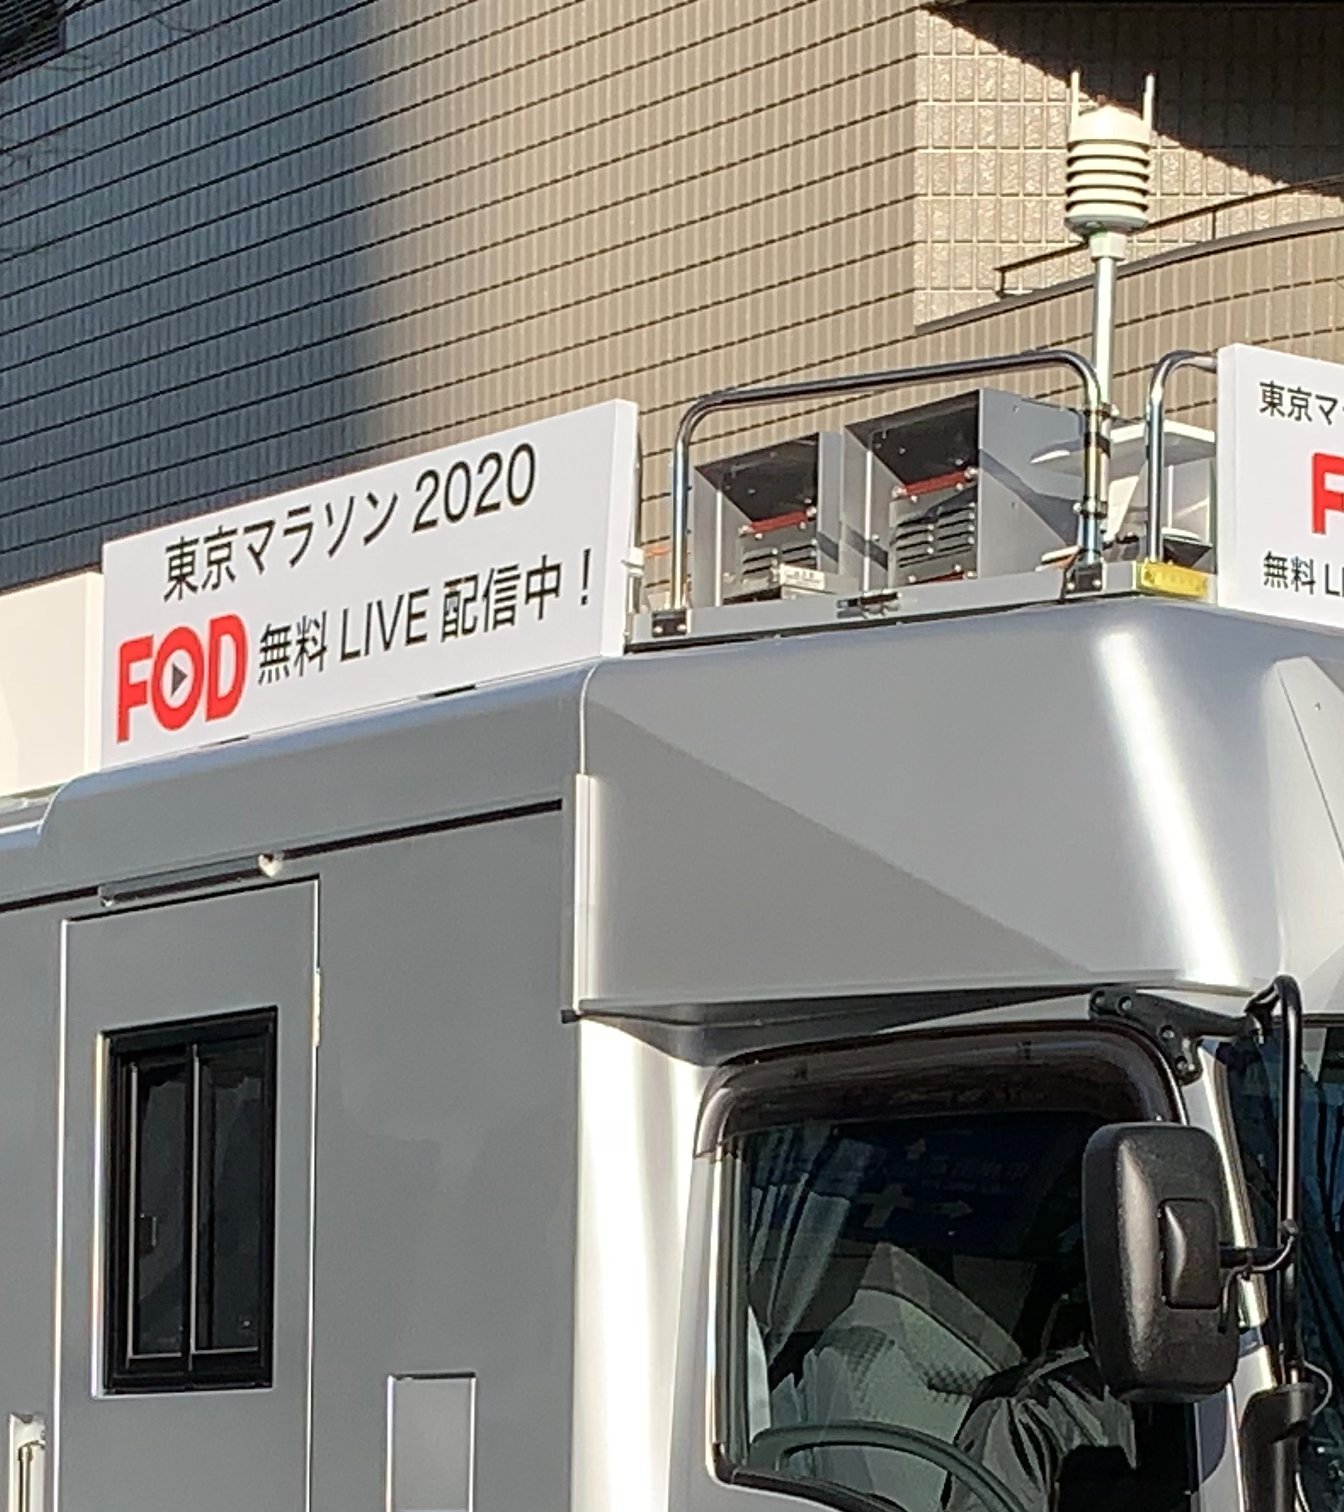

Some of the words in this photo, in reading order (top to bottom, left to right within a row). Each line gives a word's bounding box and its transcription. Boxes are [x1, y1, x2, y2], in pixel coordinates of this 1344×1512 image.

[161, 491, 400, 602] 東京マラソン
[412, 441, 537, 533] 2020
[1262, 550, 1317, 595] 無料
[115, 613, 250, 744] FOD
[256, 609, 327, 685] 無料
[338, 587, 430, 662] LIVE
